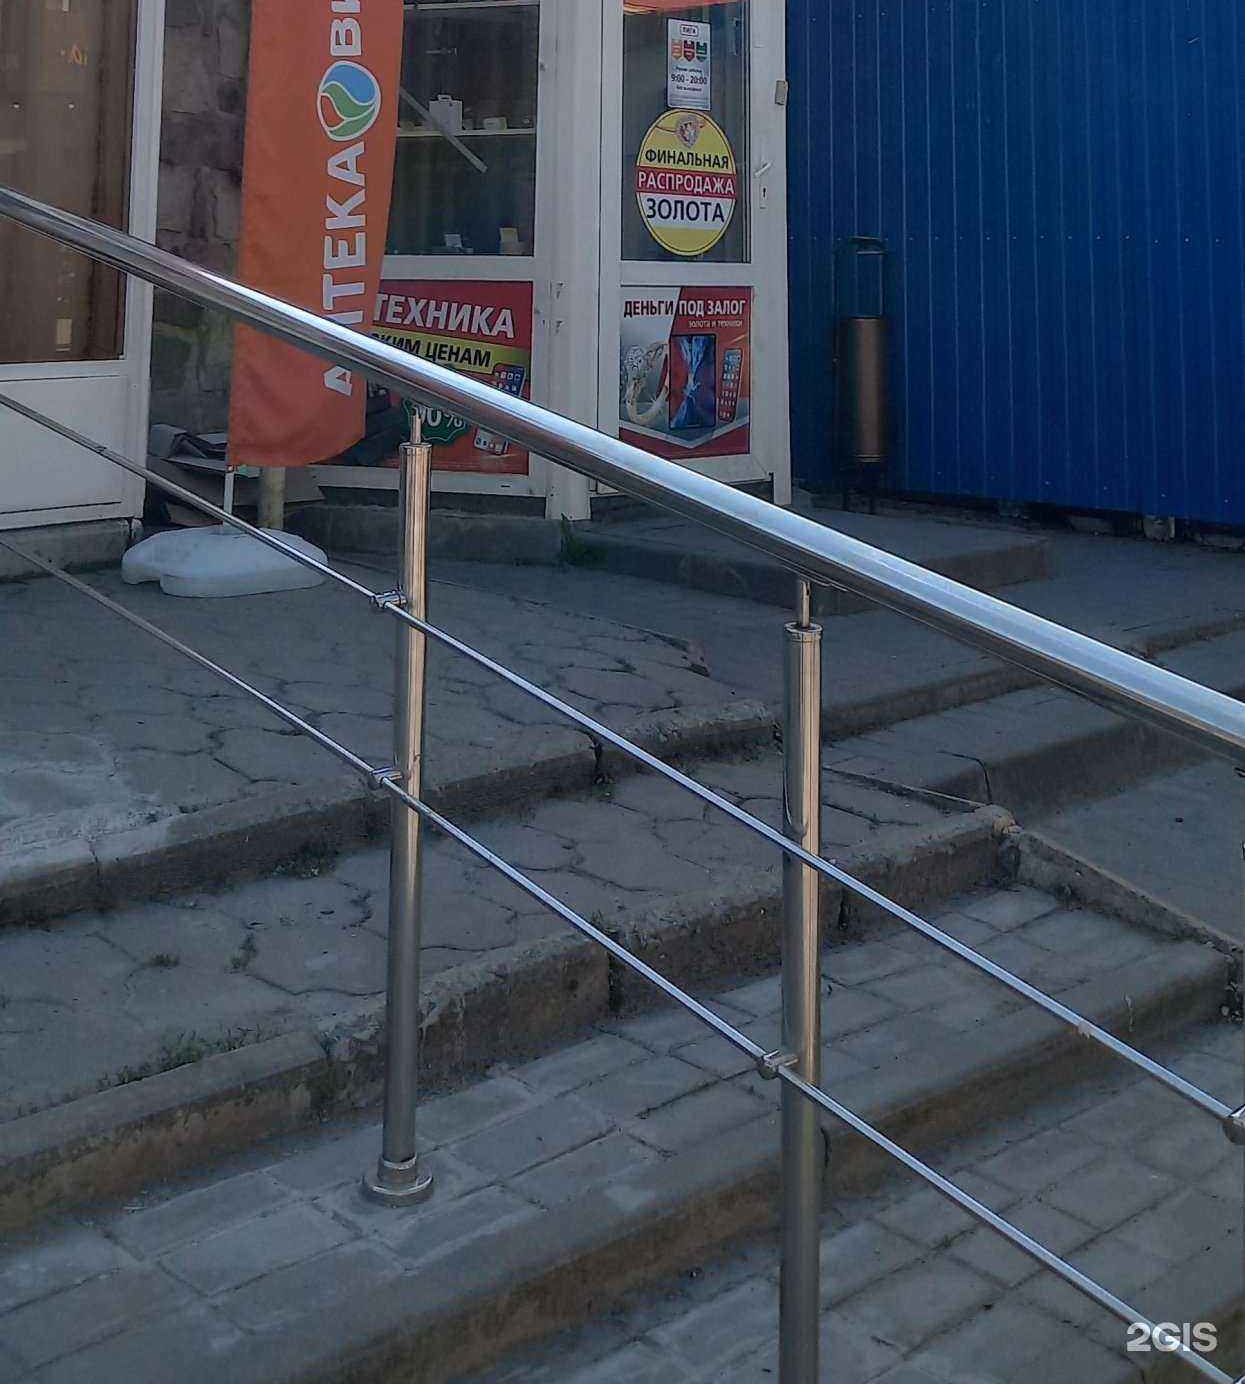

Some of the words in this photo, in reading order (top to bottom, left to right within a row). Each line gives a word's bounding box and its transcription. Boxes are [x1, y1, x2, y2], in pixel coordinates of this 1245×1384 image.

[645, 148, 729, 170] ФИНАЛЬНАЯ
[638, 171, 734, 195] РАСПРОДАЖА
[646, 198, 725, 223] ЗОЛОТА
[373, 293, 515, 339] ТЕХНИКА
[624, 300, 674, 318] ДЕНЬГИ
[679, 300, 704, 317] ПОД
[707, 300, 745, 315] ЗАЛОГ
[425, 341, 492, 367] ЦЕНАМ
